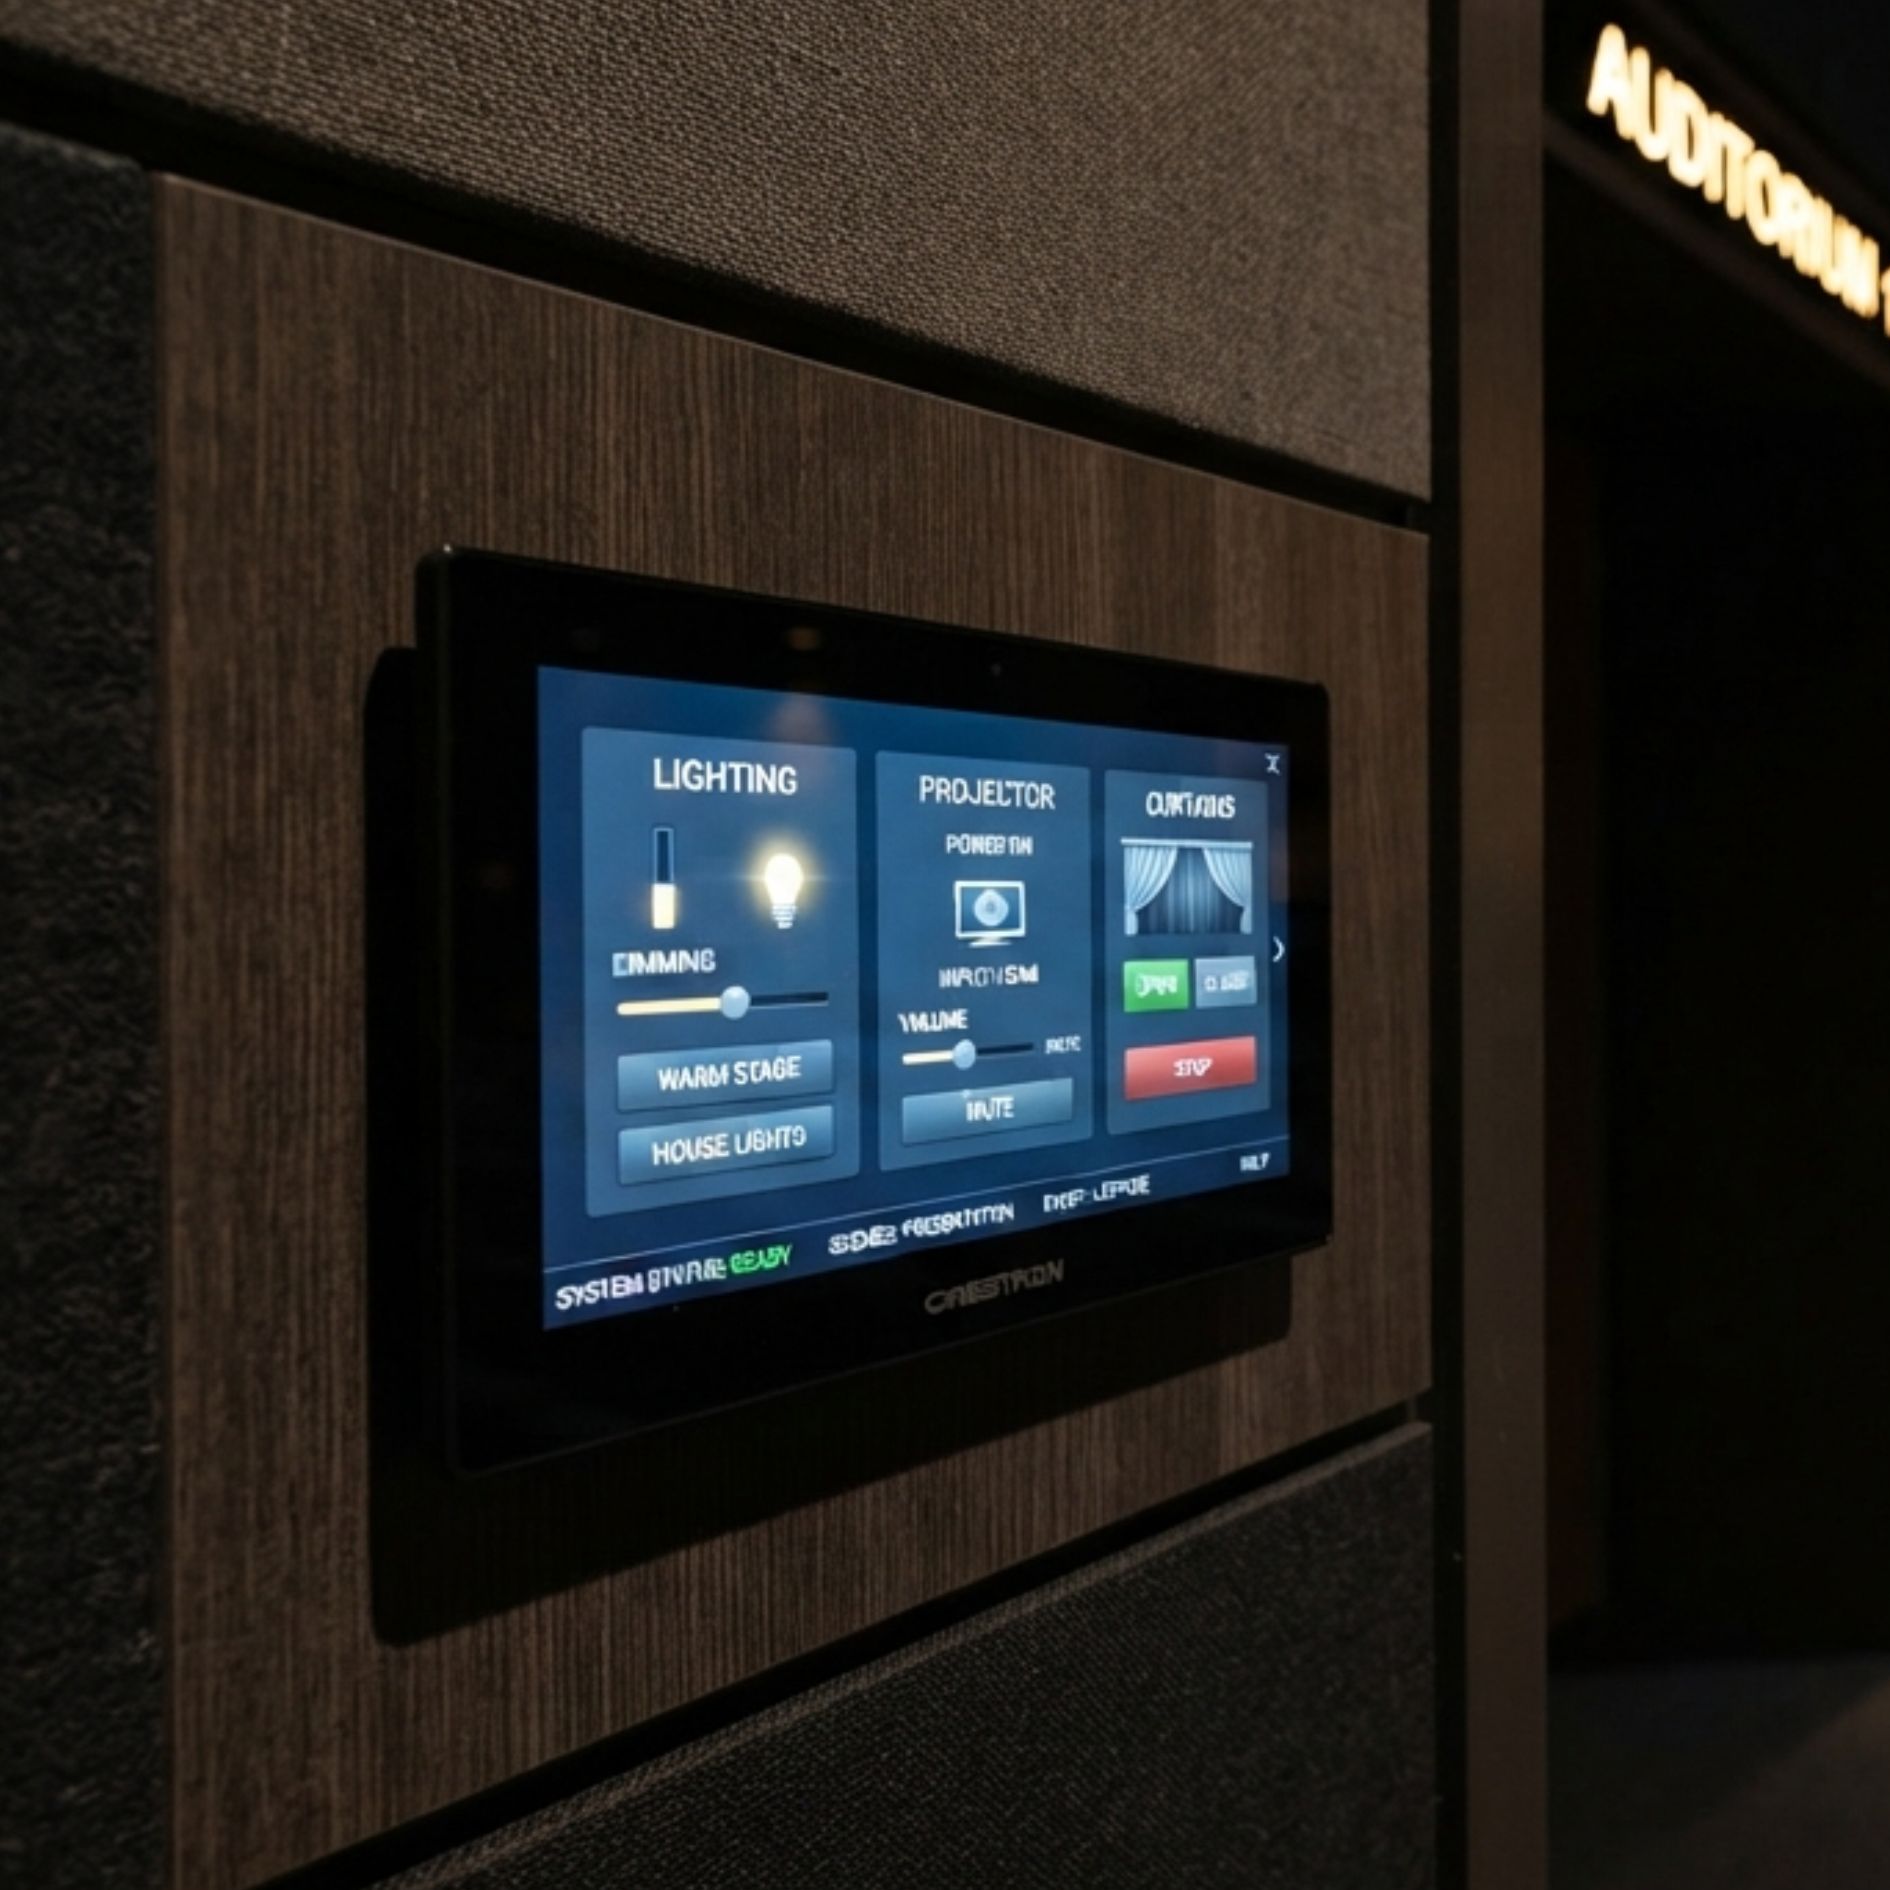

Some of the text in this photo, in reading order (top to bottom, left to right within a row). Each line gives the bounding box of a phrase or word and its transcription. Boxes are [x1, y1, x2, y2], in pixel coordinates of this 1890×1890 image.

[1586, 23, 1880, 319] AUDITORIUM
[653, 757, 798, 796] LIGHTING
[918, 774, 1056, 810] PROJECTOR
[657, 1055, 802, 1091] WARM STAGE
[652, 1132, 730, 1166] HOUSE
